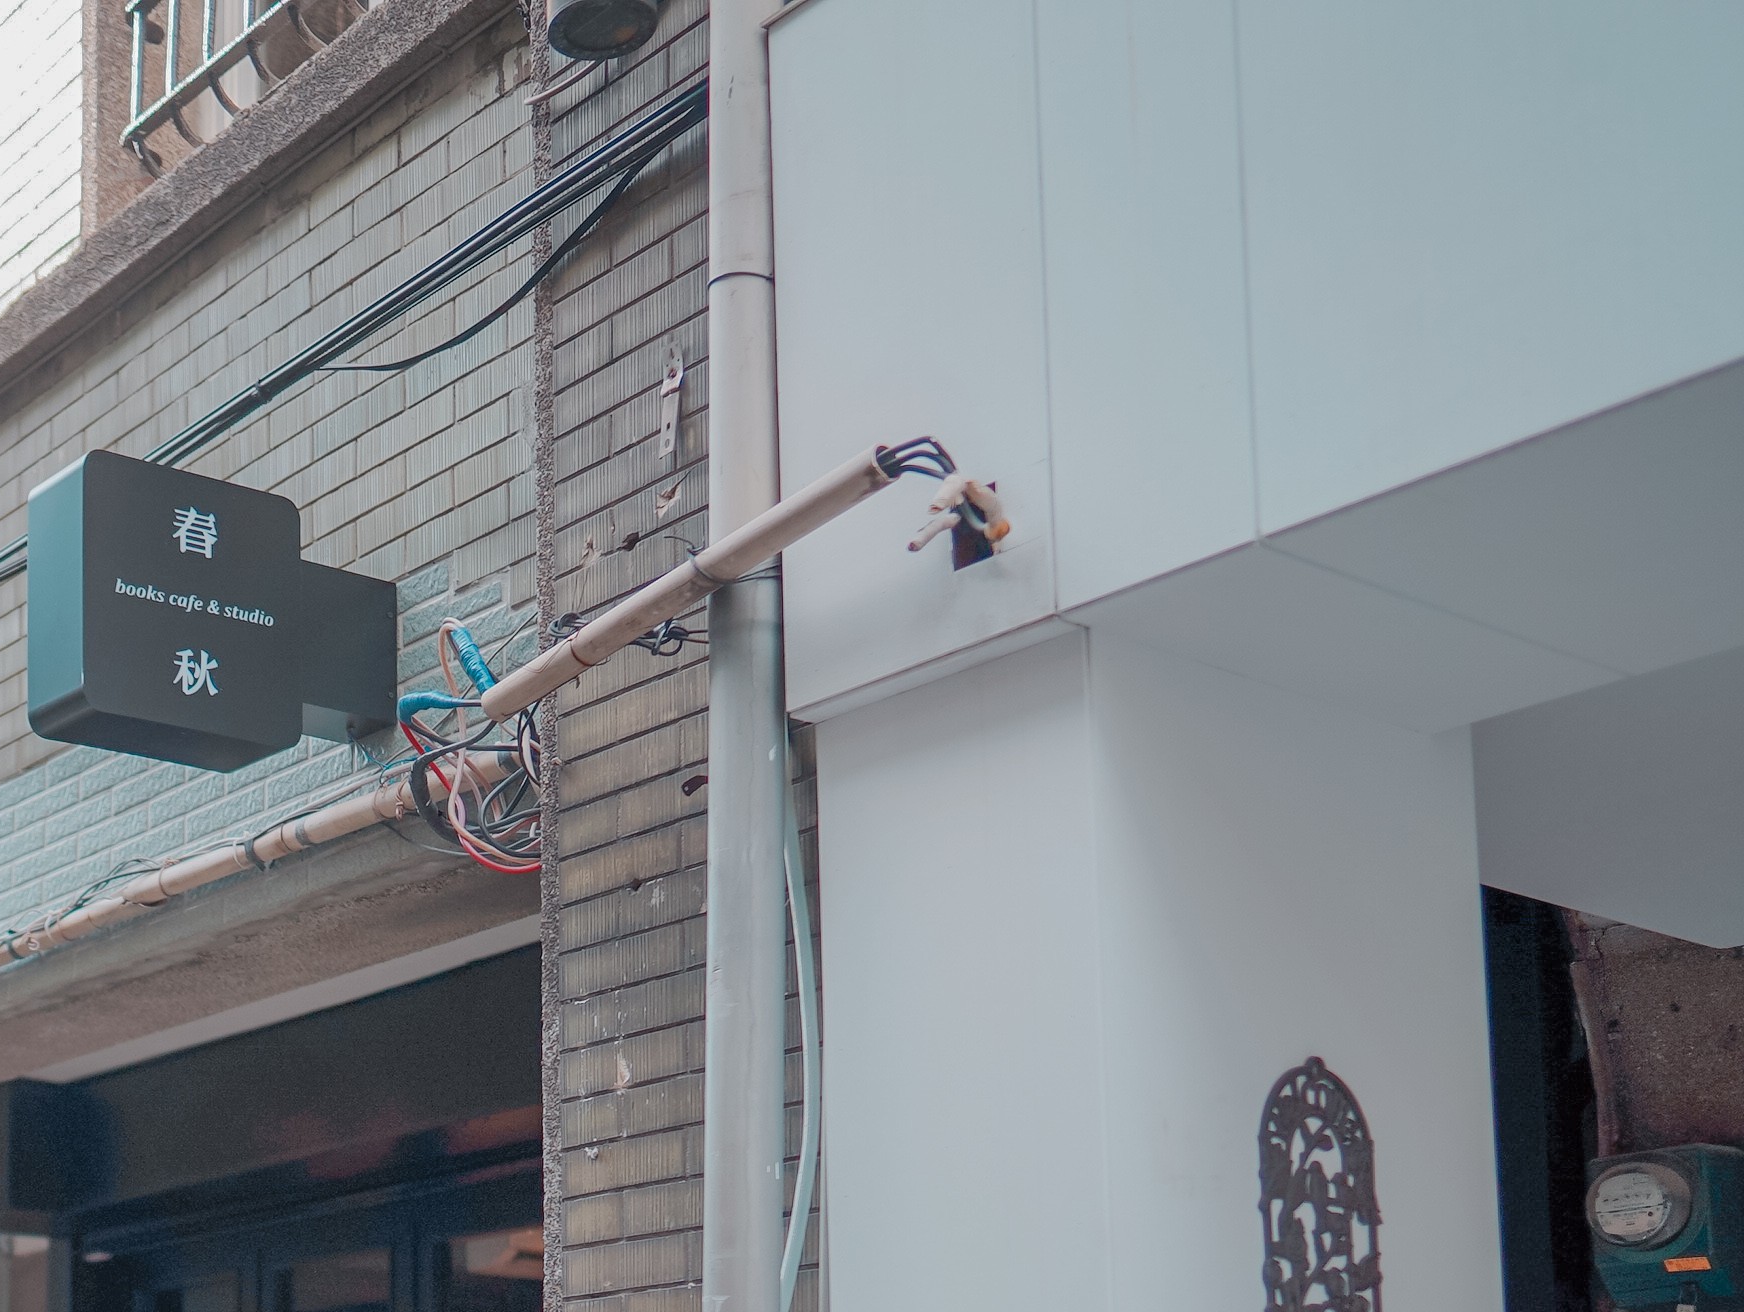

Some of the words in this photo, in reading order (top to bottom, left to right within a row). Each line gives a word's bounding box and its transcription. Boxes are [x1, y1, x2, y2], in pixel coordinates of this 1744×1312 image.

[171, 506, 218, 559] 春
[115, 578, 165, 603] books
[168, 593, 203, 613] cafe
[207, 599, 220, 615] &
[223, 605, 274, 627] studio
[173, 649, 219, 696] 秋
